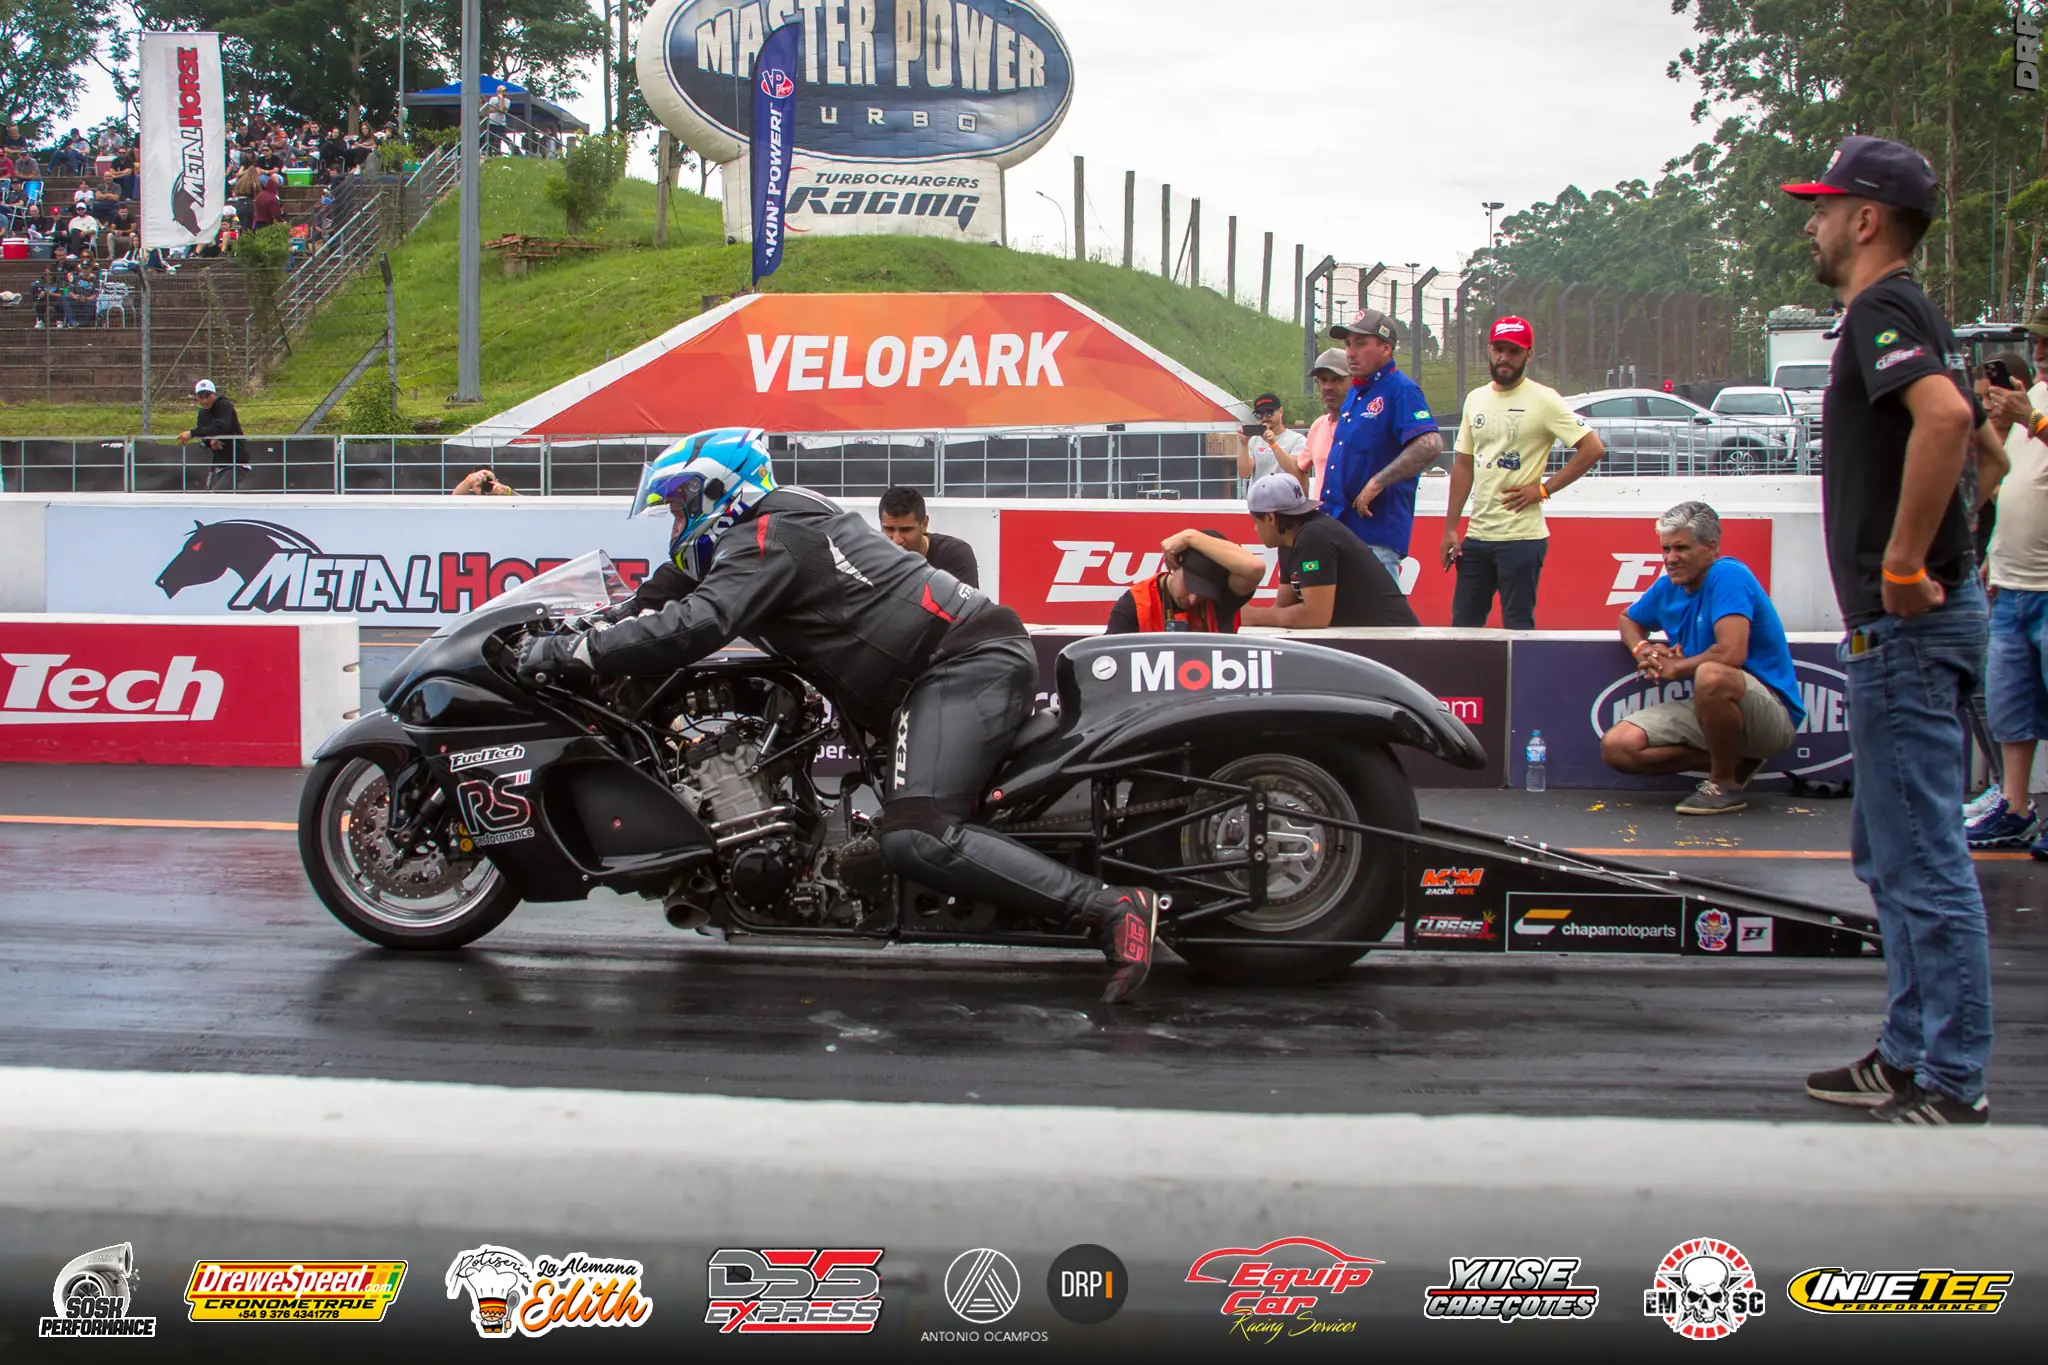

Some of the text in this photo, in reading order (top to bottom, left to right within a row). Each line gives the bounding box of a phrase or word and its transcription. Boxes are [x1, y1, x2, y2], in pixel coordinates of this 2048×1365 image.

[894, 0, 1046, 92] POWER
[177, 47, 204, 207] METALHORSE
[820, 106, 977, 132] URBO
[765, 106, 783, 266] AKIN' POWER!
[784, 186, 980, 232] Racing
[815, 172, 980, 189] TURBOCHARGERS
[747, 331, 1069, 393] VELOPARK
[231, 551, 650, 614] METALHOE
[0, 653, 224, 721] Tech
[450, 746, 524, 769] FuelTech
[894, 710, 910, 790] TEXX
[457, 769, 531, 835] RS
[1562, 922, 1677, 938] chapamotoparts
